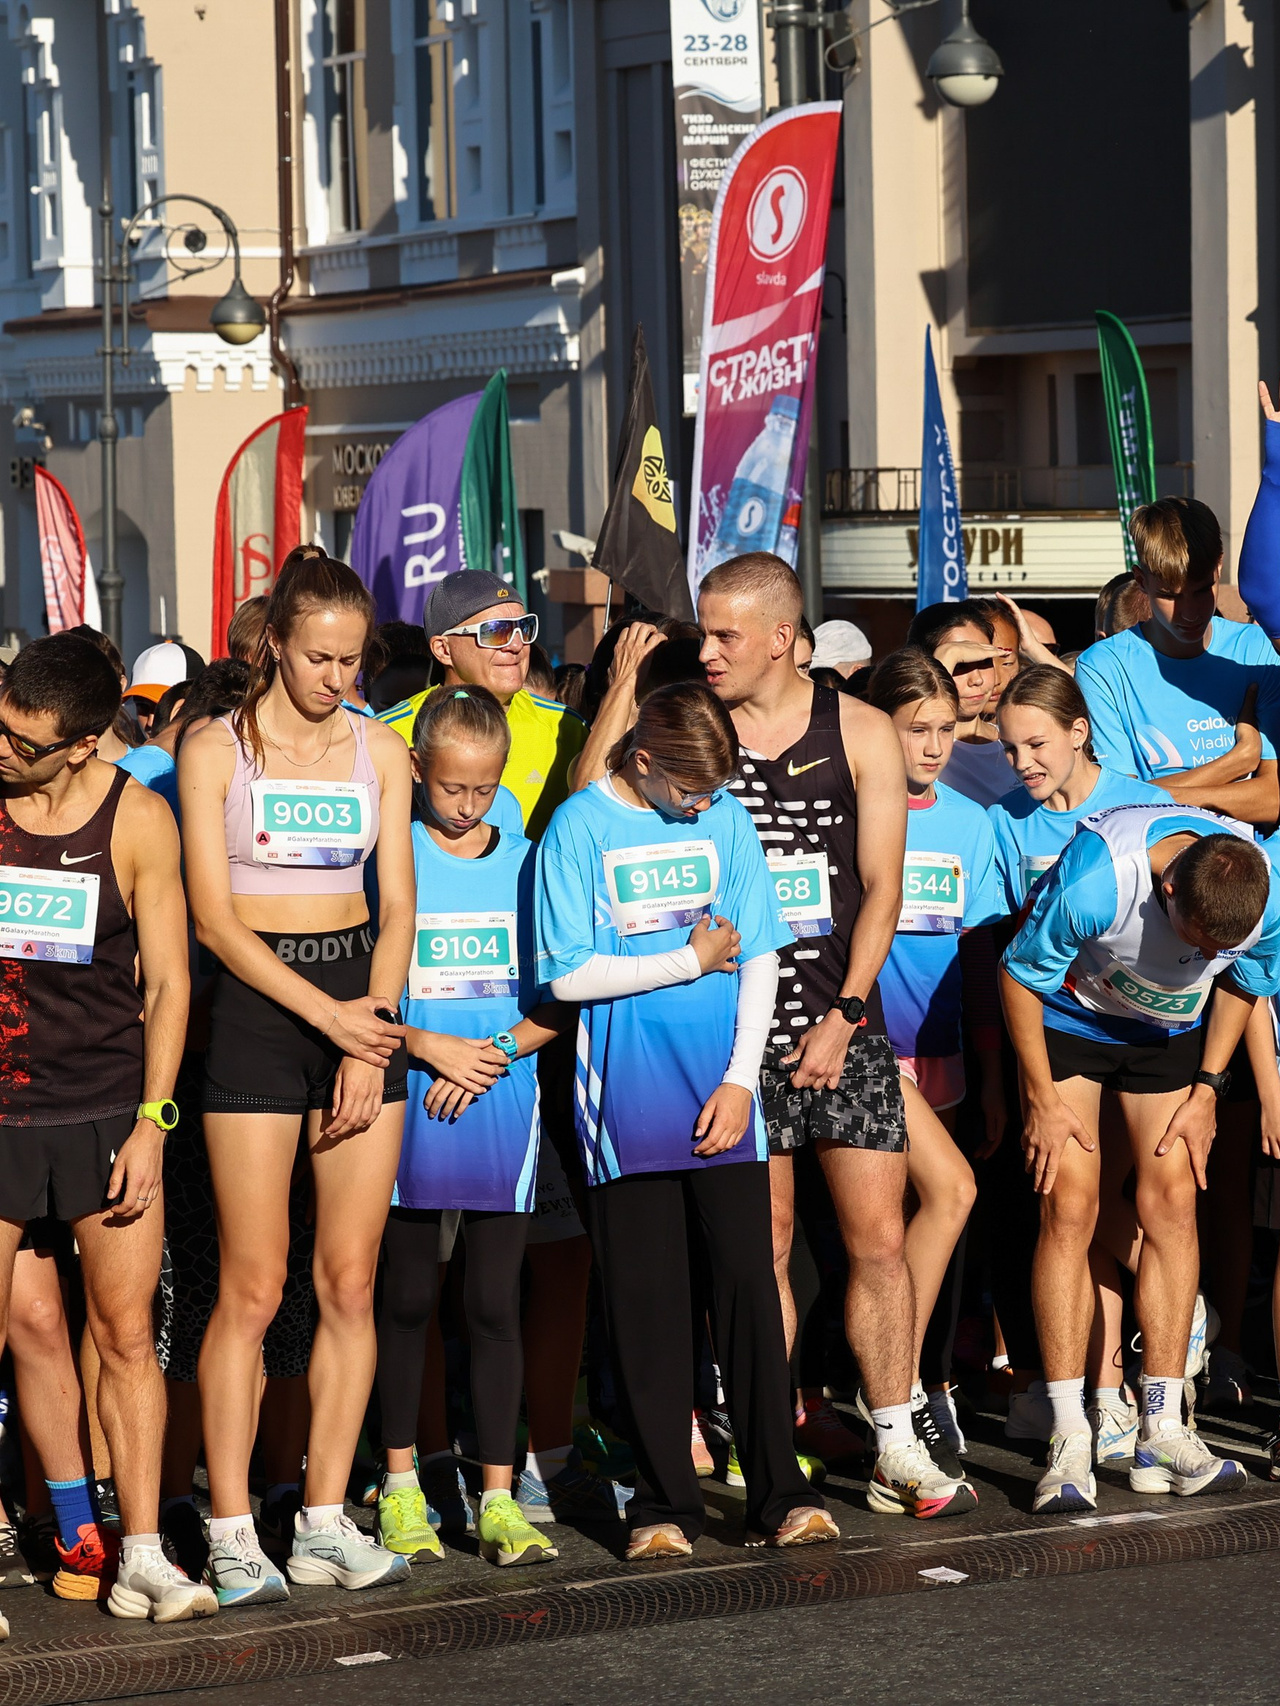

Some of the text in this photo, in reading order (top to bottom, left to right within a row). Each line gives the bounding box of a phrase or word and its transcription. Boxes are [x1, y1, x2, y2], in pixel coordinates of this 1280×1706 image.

[684, 35, 748, 51] 23-28
[684, 57, 748, 66] СЕНТЯБРЯ
[682, 114, 714, 124] ТИХО
[683, 136, 729, 145] МАРШИ
[756, 271, 787, 286] slavda
[274, 801, 352, 826] 9003
[630, 864, 698, 894] 9145
[0, 890, 73, 921] 9672
[642, 899, 695, 910] #GalaxyMarathon
[0, 927, 60, 938] #GalaxyMarathon
[791, 922, 819, 935] 3km
[45, 944, 77, 959] 3km
[276, 933, 354, 963] BODY
[430, 935, 499, 960] 9104
[508, 967, 515, 976] C
[483, 983, 510, 994] 3km
[1121, 982, 1188, 1010] 9573
[1146, 1381, 1167, 1416] RUSSIA
